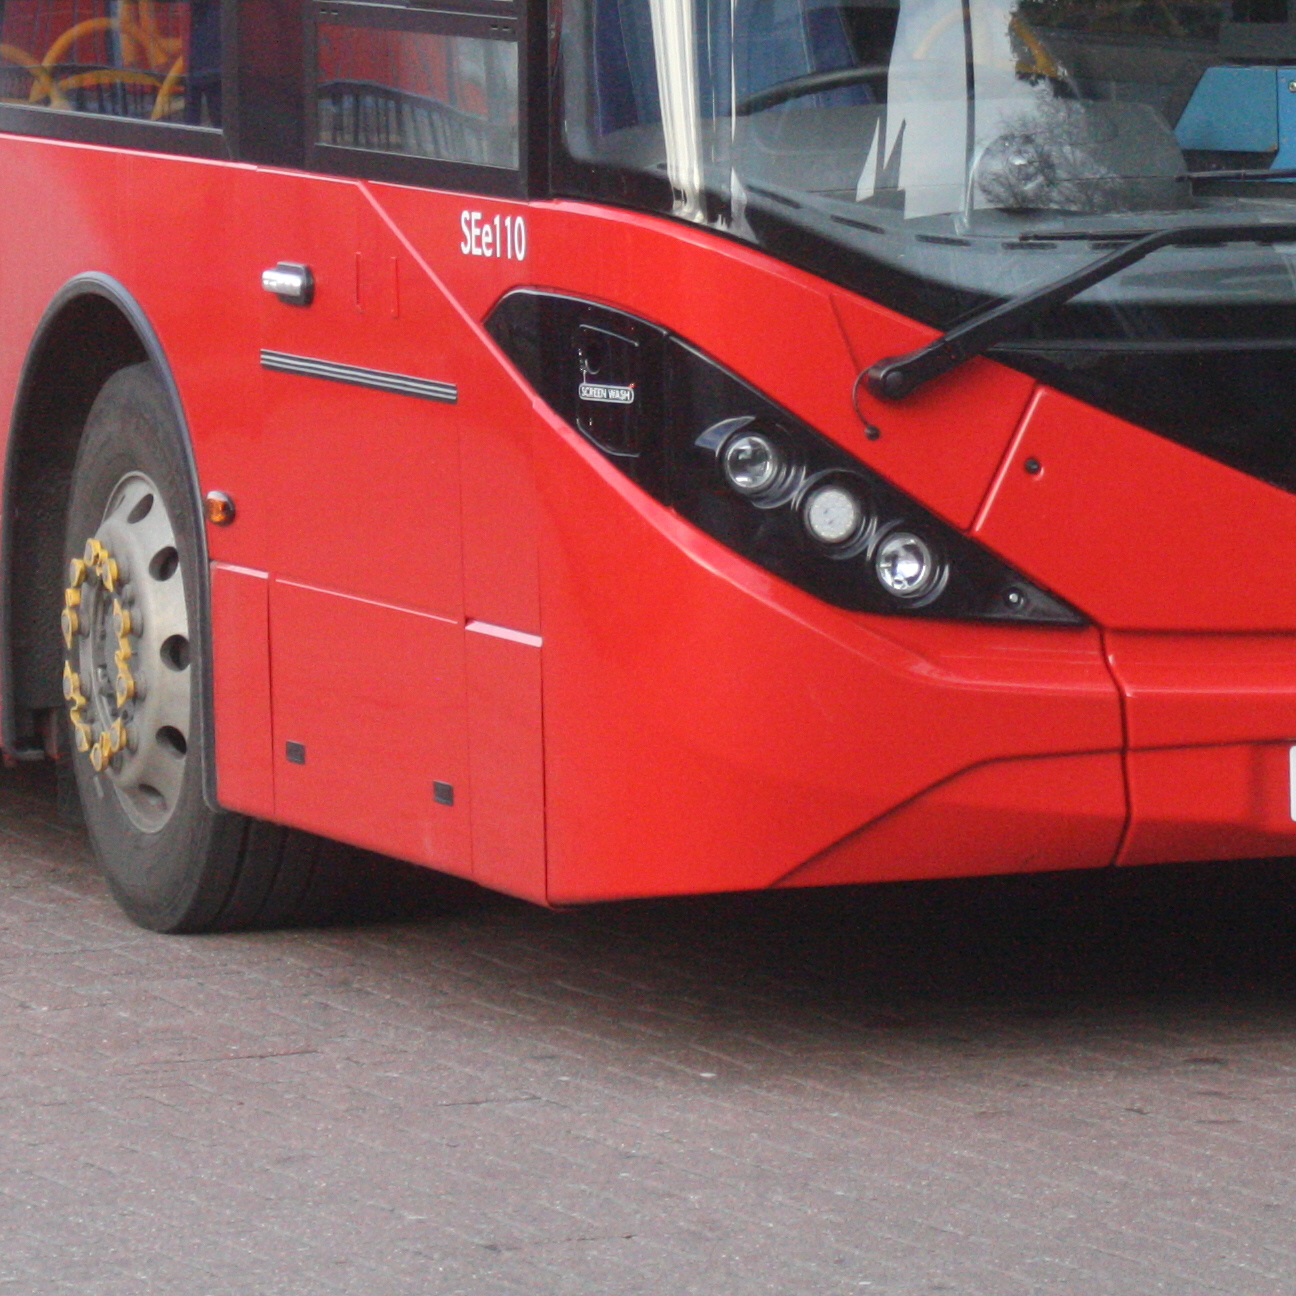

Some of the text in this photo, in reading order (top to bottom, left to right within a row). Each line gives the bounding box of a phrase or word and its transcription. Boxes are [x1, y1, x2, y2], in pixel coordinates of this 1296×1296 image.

[460, 209, 526, 261] SEe110
[581, 386, 630, 401] SCREEN WASH
